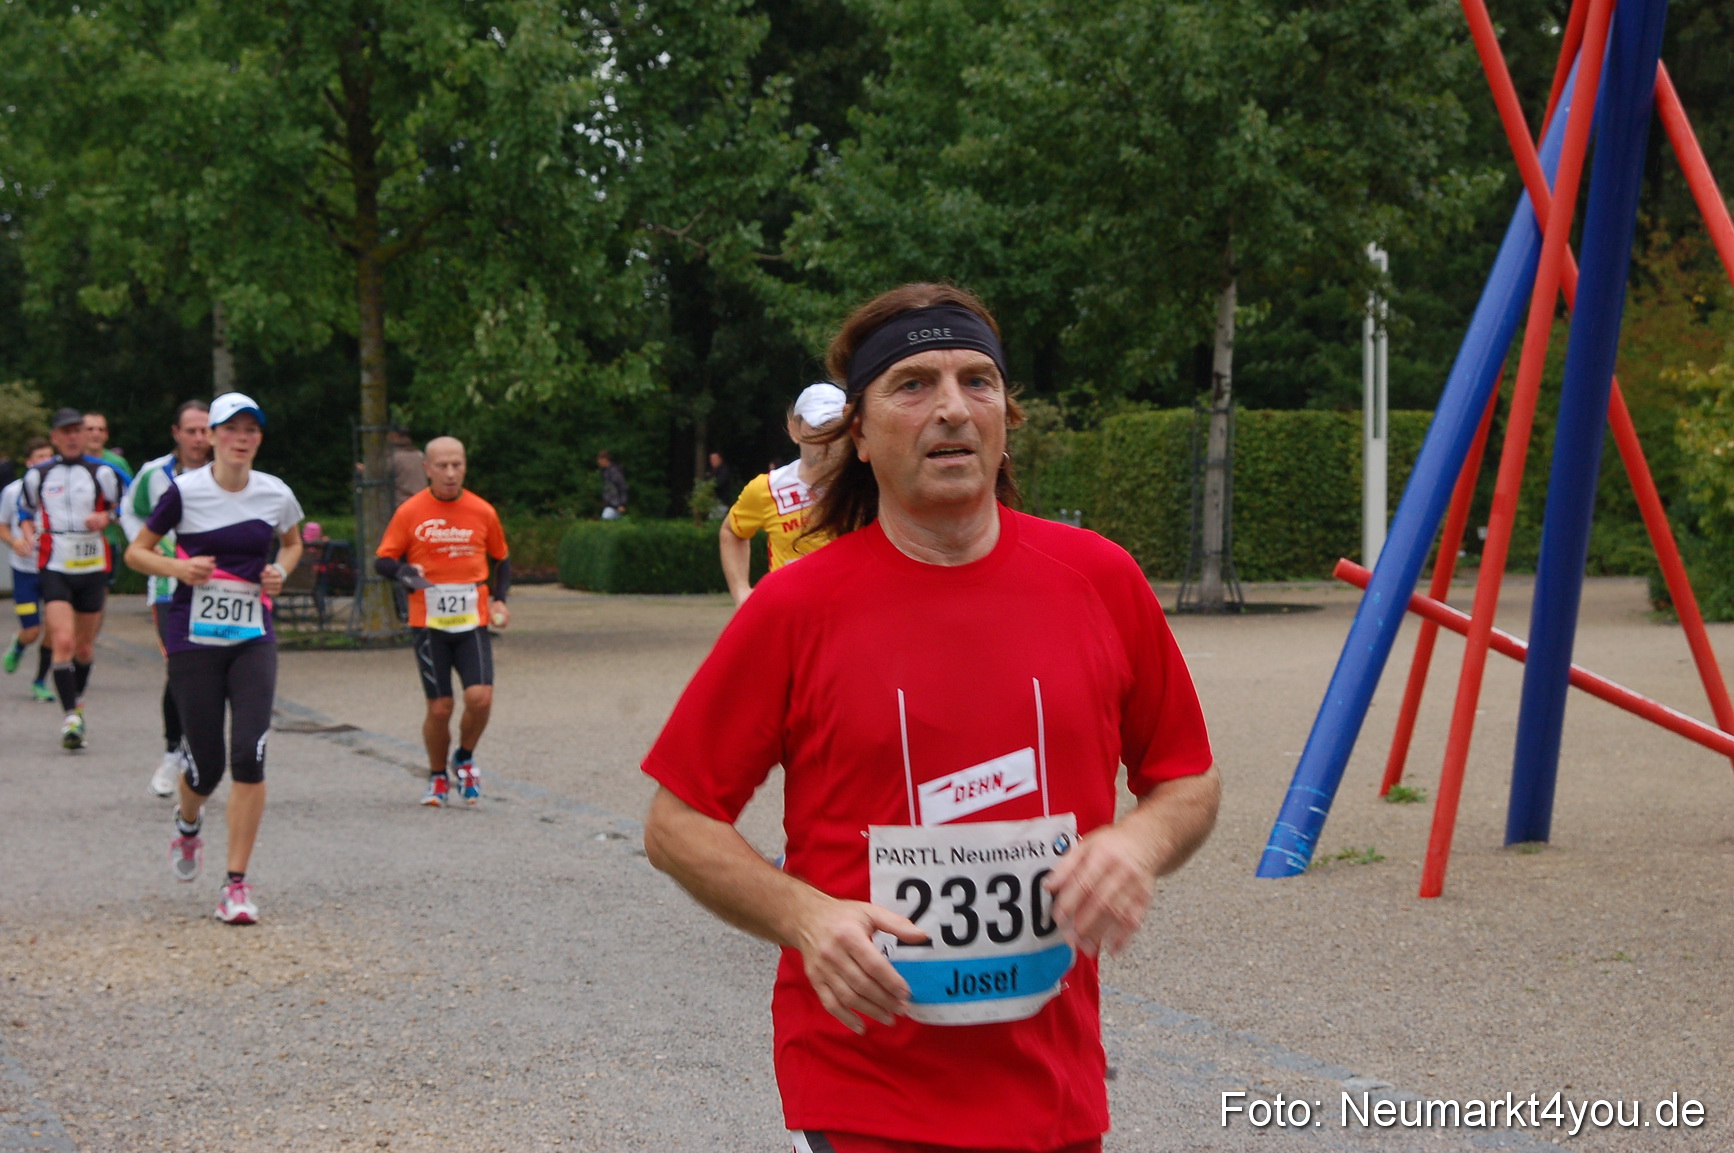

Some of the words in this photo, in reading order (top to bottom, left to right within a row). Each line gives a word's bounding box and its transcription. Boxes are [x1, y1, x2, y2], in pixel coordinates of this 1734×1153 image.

[907, 327, 953, 341] GORE
[201, 595, 254, 623] 2501
[437, 595, 467, 613] 421
[954, 771, 1004, 804] DEHN
[875, 847, 946, 866] PARTL
[951, 840, 1046, 865] Neumarkt
[896, 868, 1058, 948] 2330
[945, 964, 1018, 997] Josef
